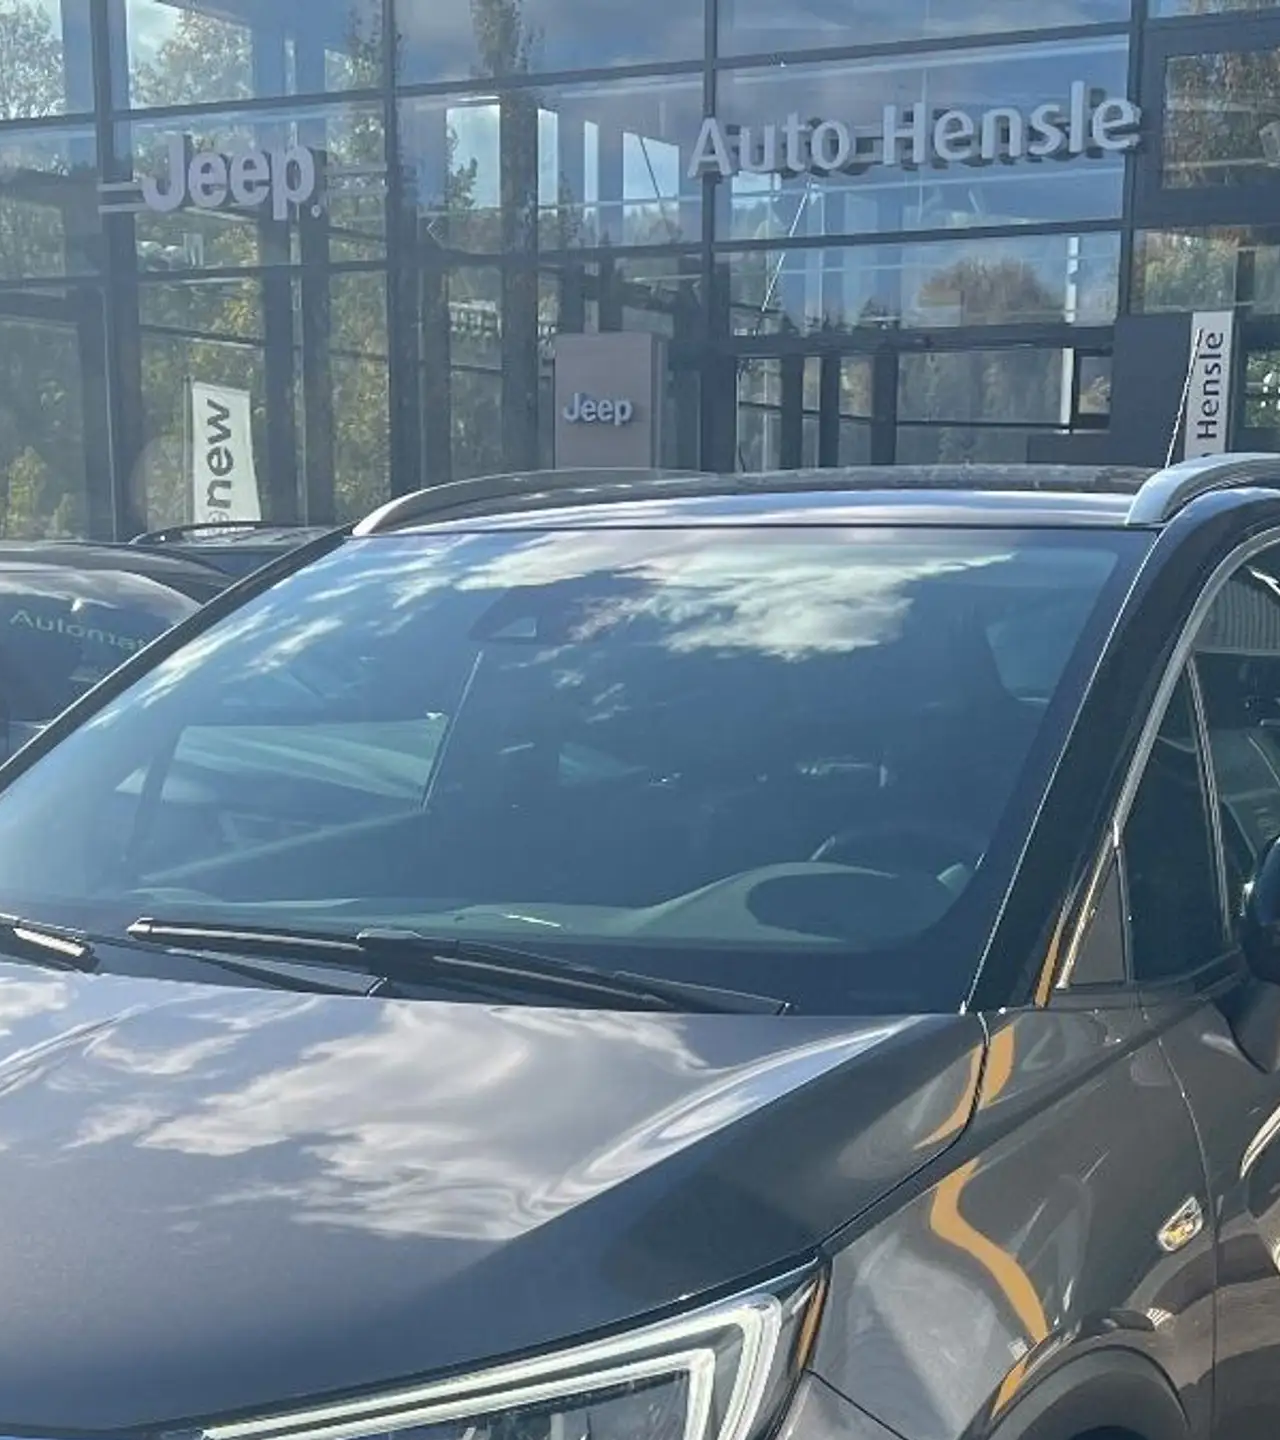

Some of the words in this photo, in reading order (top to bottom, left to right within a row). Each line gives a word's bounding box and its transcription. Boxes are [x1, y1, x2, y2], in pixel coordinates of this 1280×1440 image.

[141, 131, 316, 221] Jeep
[688, 113, 850, 178] Auto
[883, 80, 1142, 166] Hensle
[563, 392, 633, 426] Jeep
[1196, 329, 1224, 440] Hensle
